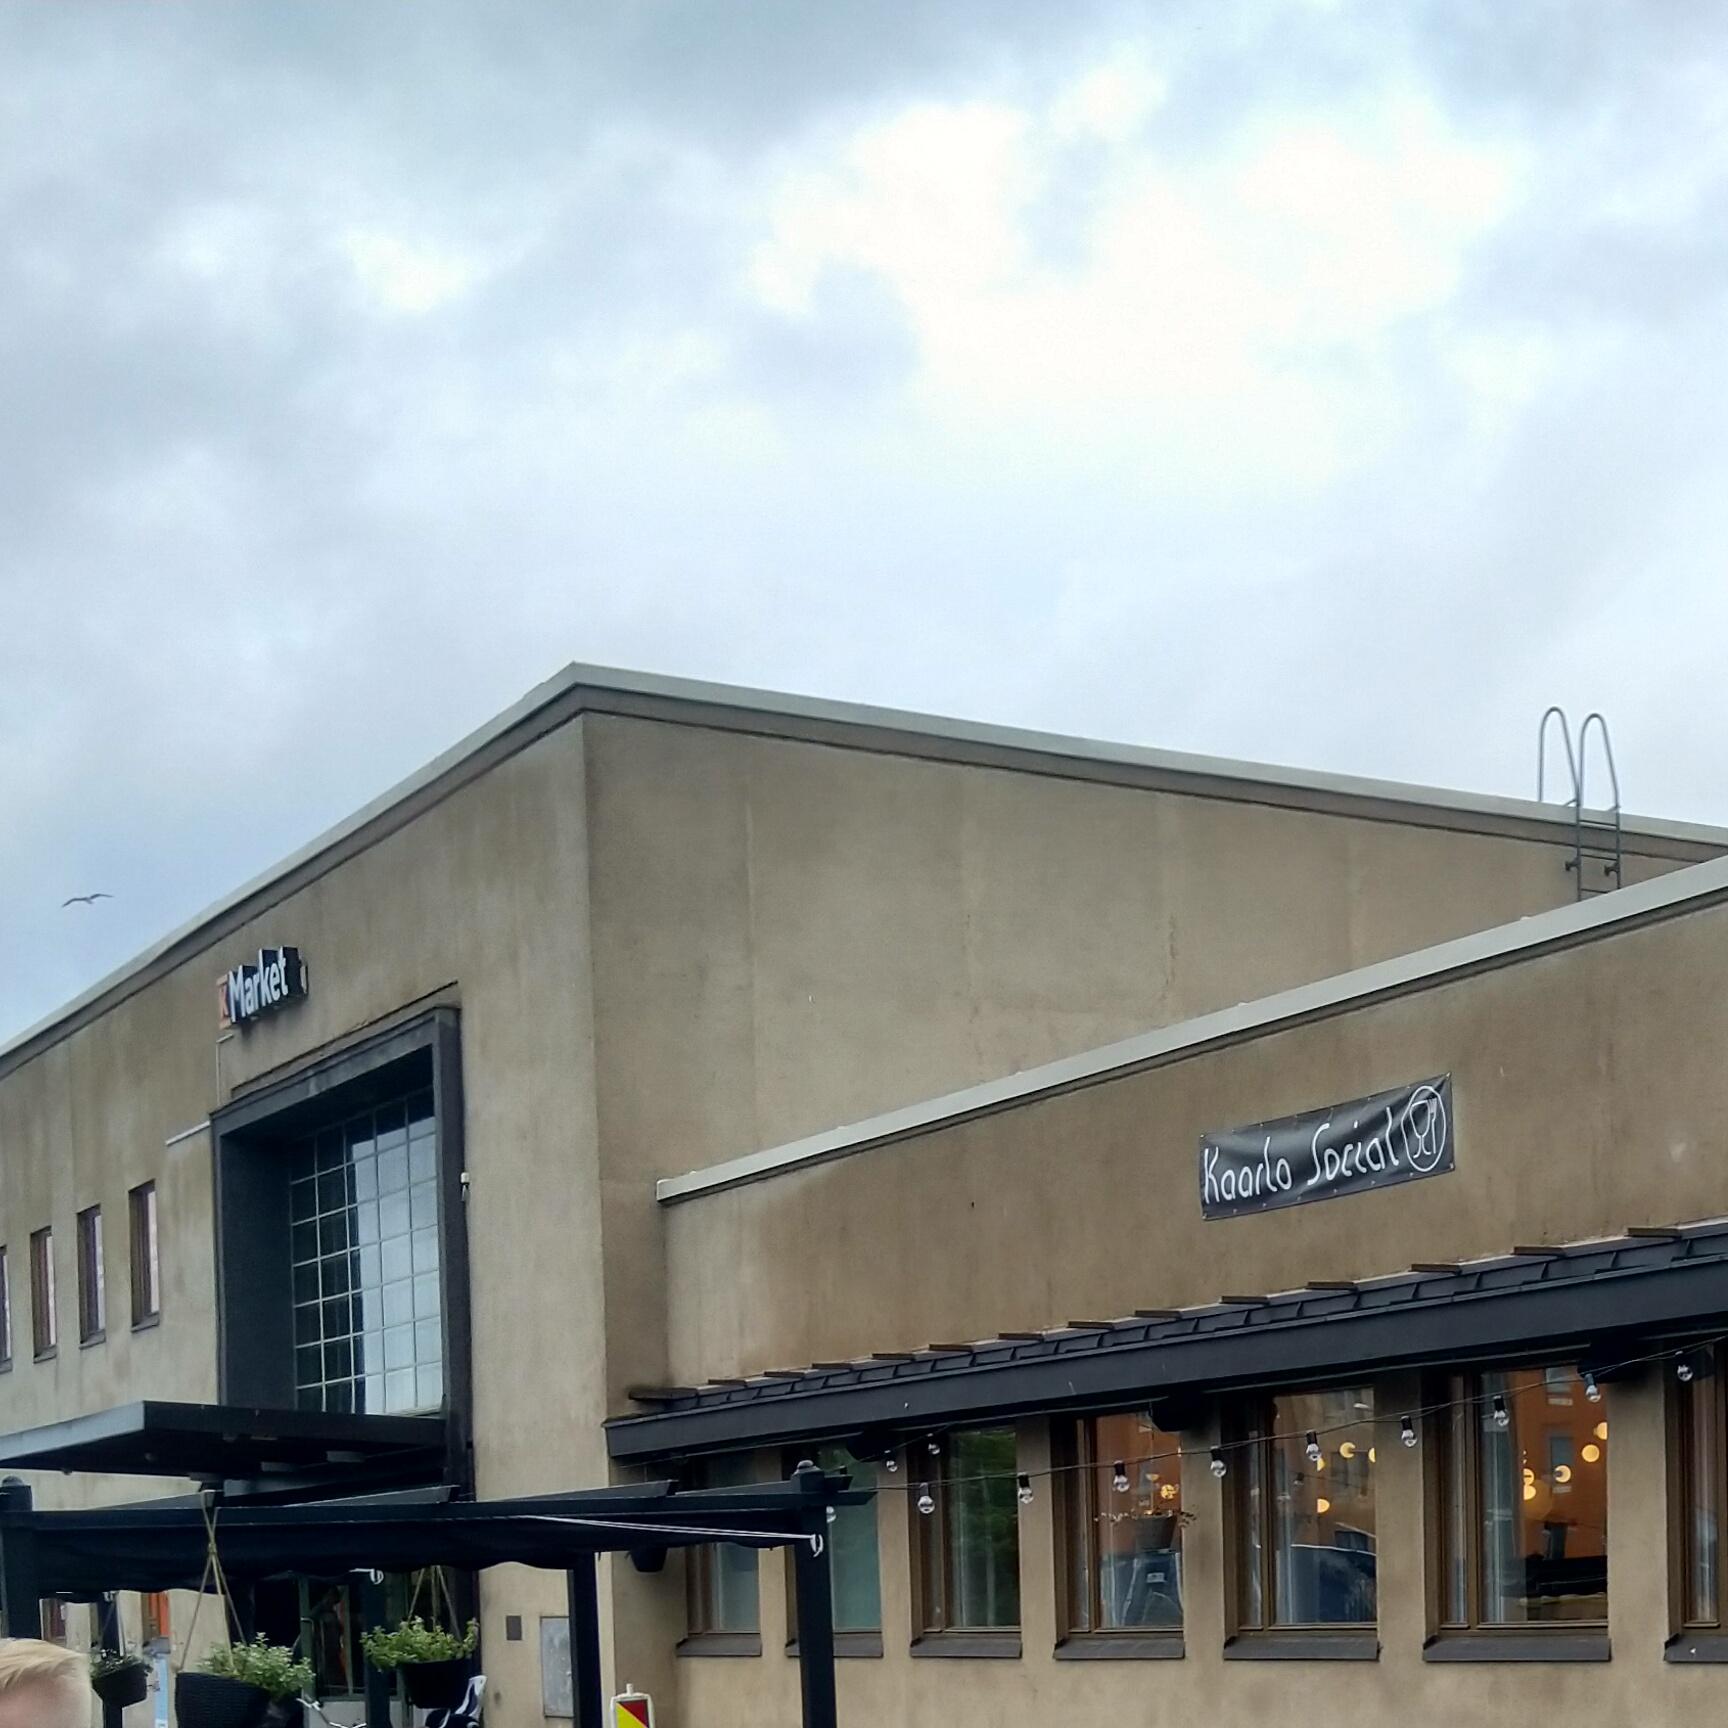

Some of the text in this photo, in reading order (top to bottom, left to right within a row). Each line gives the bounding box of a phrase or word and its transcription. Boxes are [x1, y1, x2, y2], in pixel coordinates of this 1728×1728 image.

[228, 945, 289, 1023] Market
[1203, 1105, 1400, 1205] Kaarlo Social
